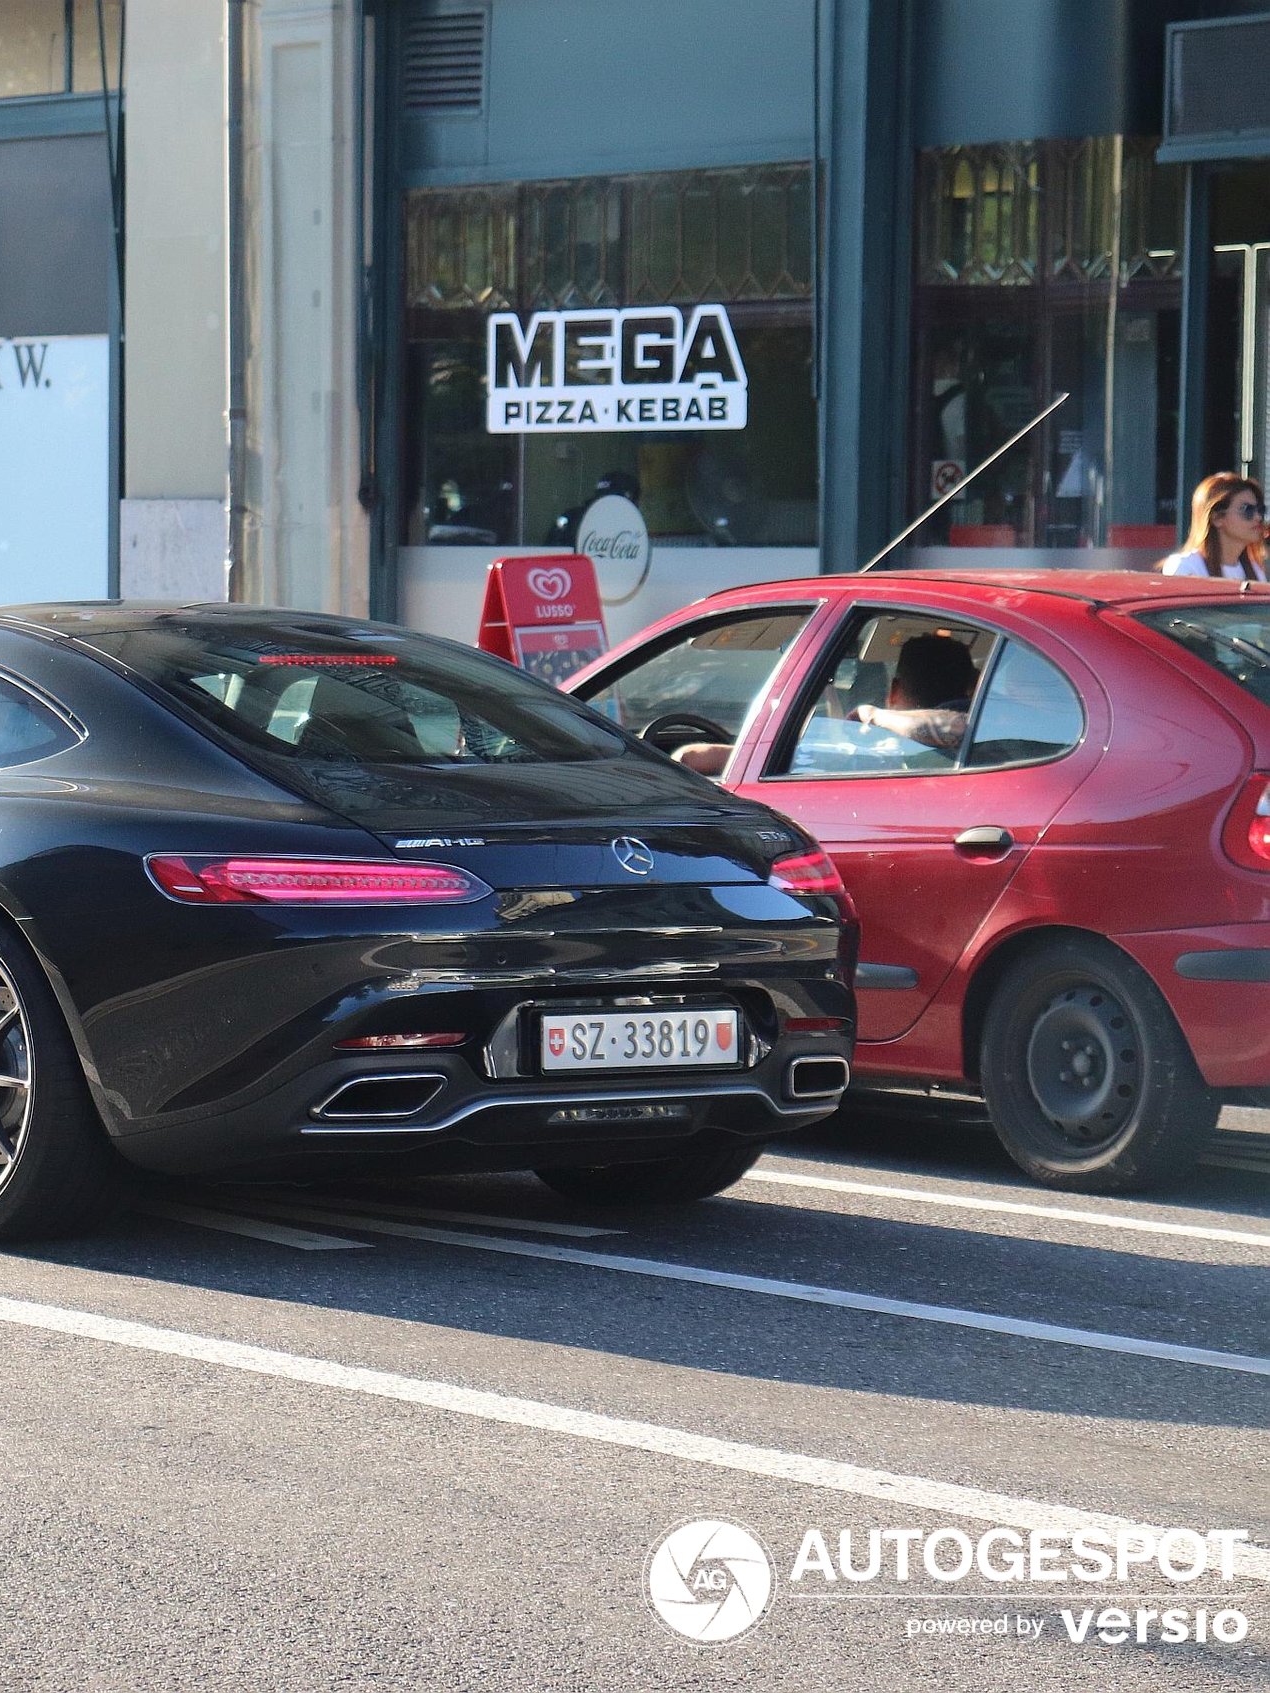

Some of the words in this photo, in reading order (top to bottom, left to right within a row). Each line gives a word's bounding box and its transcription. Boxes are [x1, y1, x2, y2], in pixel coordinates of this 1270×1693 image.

[13, 343, 52, 388] W.
[489, 304, 747, 391] MEGA
[504, 400, 598, 425] PIZZA
[617, 397, 729, 423] KEBAB
[535, 604, 574, 618] LUSSO
